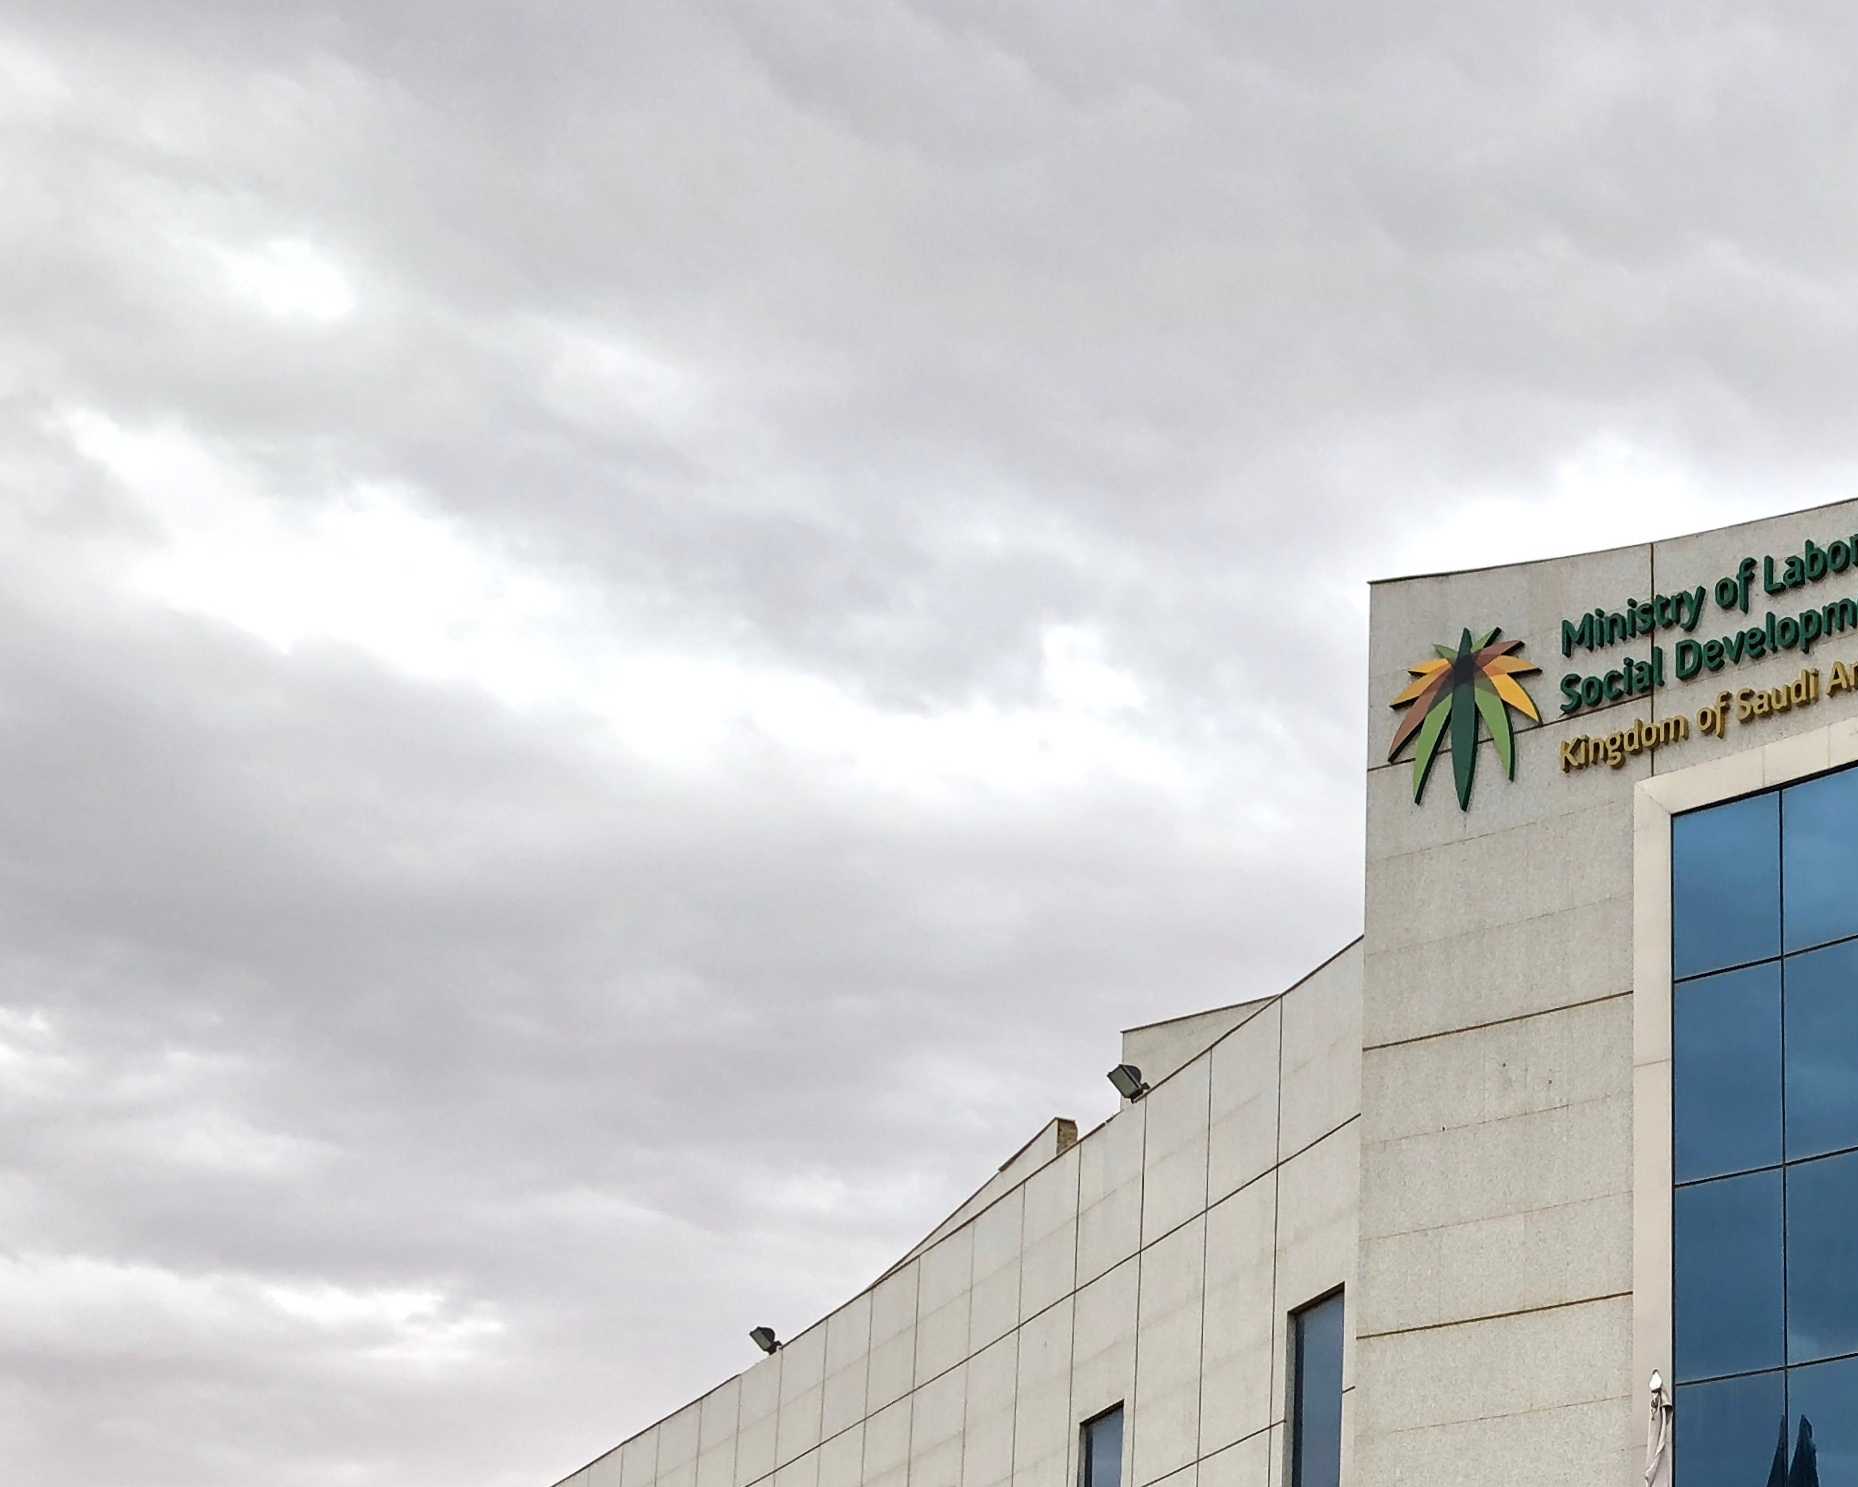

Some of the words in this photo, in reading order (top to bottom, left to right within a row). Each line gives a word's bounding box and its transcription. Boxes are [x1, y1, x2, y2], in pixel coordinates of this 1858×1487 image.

[1560, 583, 1705, 658] Ministry
[1715, 556, 1757, 614] of
[1559, 646, 1665, 715] Social
[1560, 716, 1689, 773] Kingdom
[1696, 691, 1730, 739] of
[1736, 663, 1819, 724] Saudi
